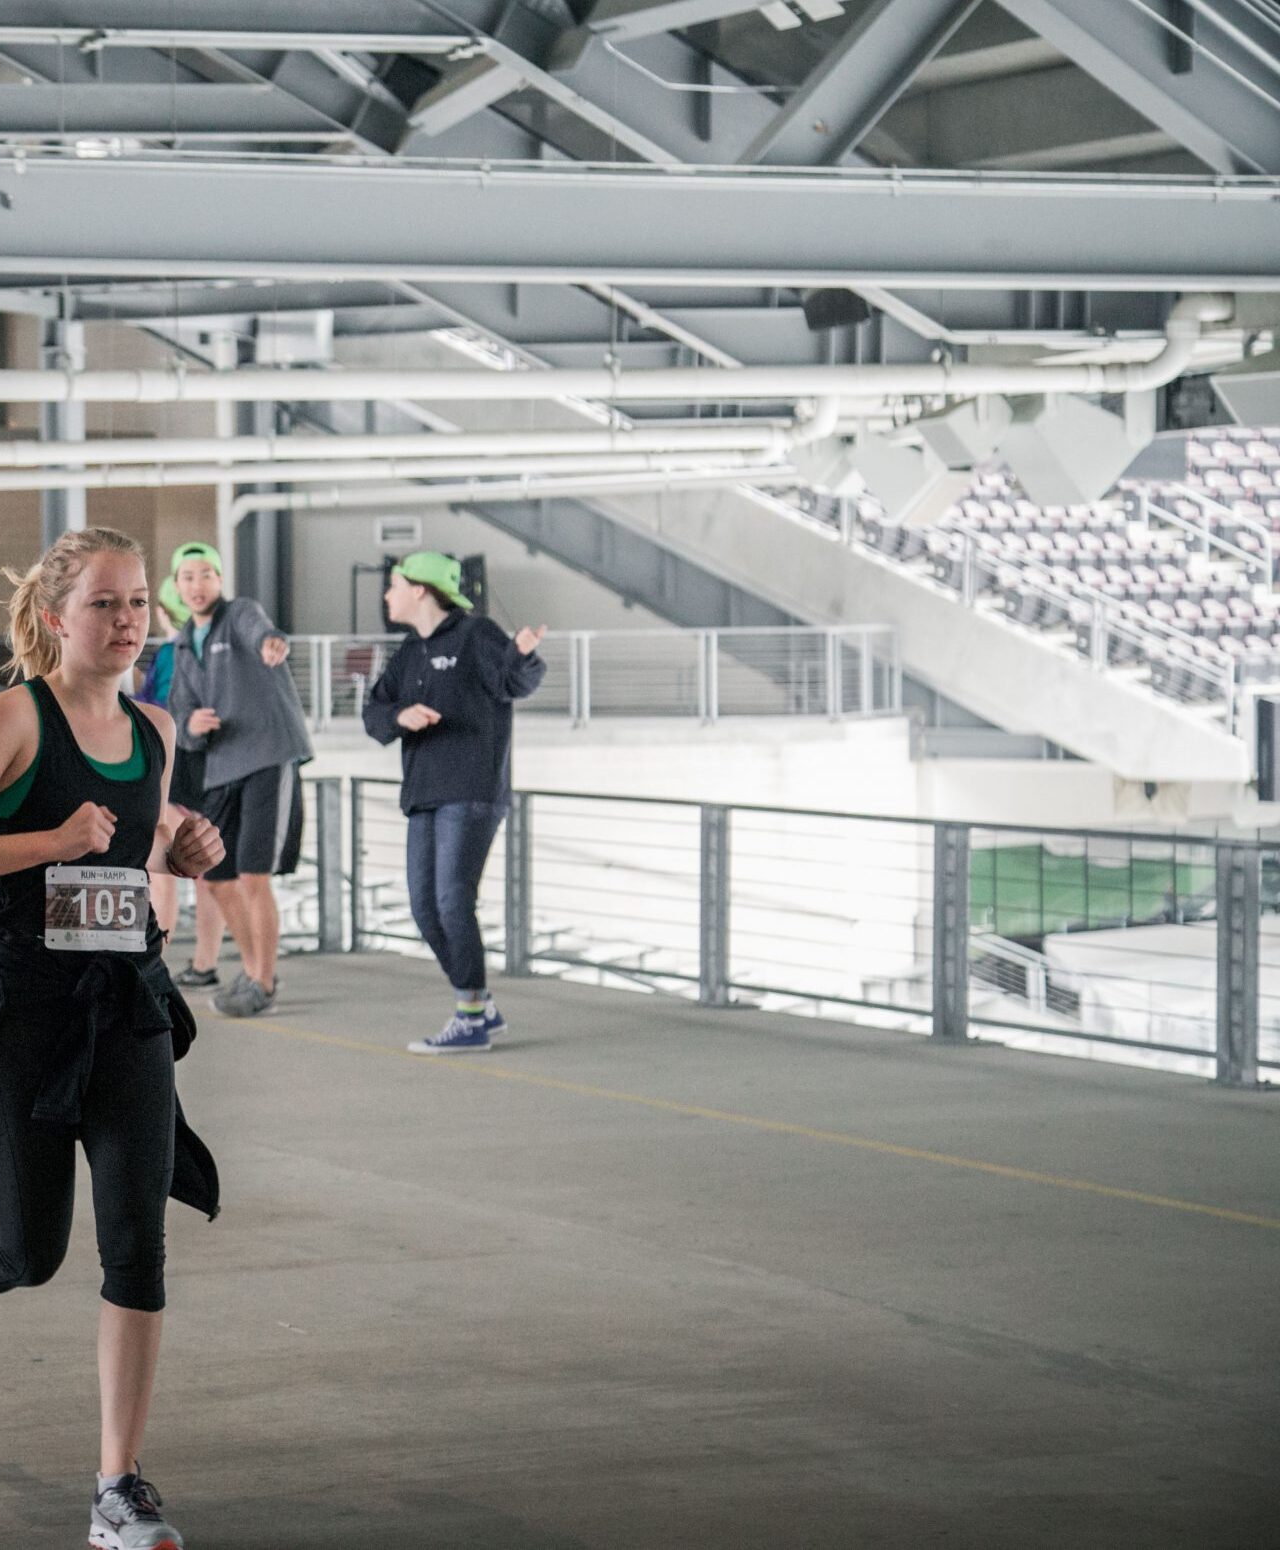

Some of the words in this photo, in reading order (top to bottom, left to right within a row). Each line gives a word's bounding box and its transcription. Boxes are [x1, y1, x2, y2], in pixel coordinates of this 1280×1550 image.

[80, 870, 96, 879] RUN
[104, 871, 127, 880] RAMPS
[71, 888, 137, 926] 105
